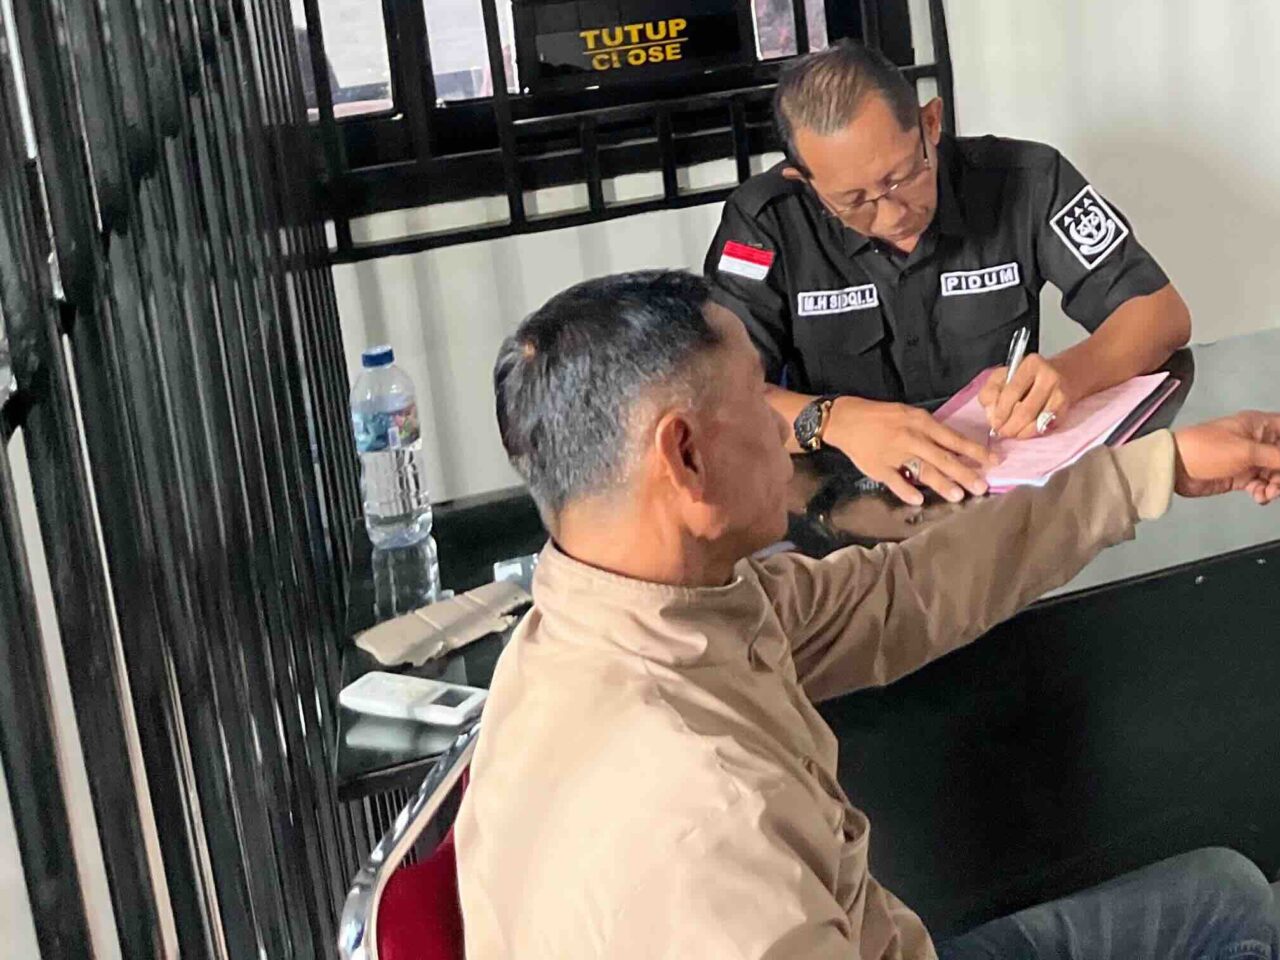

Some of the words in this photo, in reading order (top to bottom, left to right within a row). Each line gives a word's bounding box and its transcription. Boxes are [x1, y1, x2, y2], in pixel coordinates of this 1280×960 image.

[579, 18, 687, 49] TUTUP
[592, 43, 682, 71] CLOSE
[946, 267, 1014, 292] PIDUM
